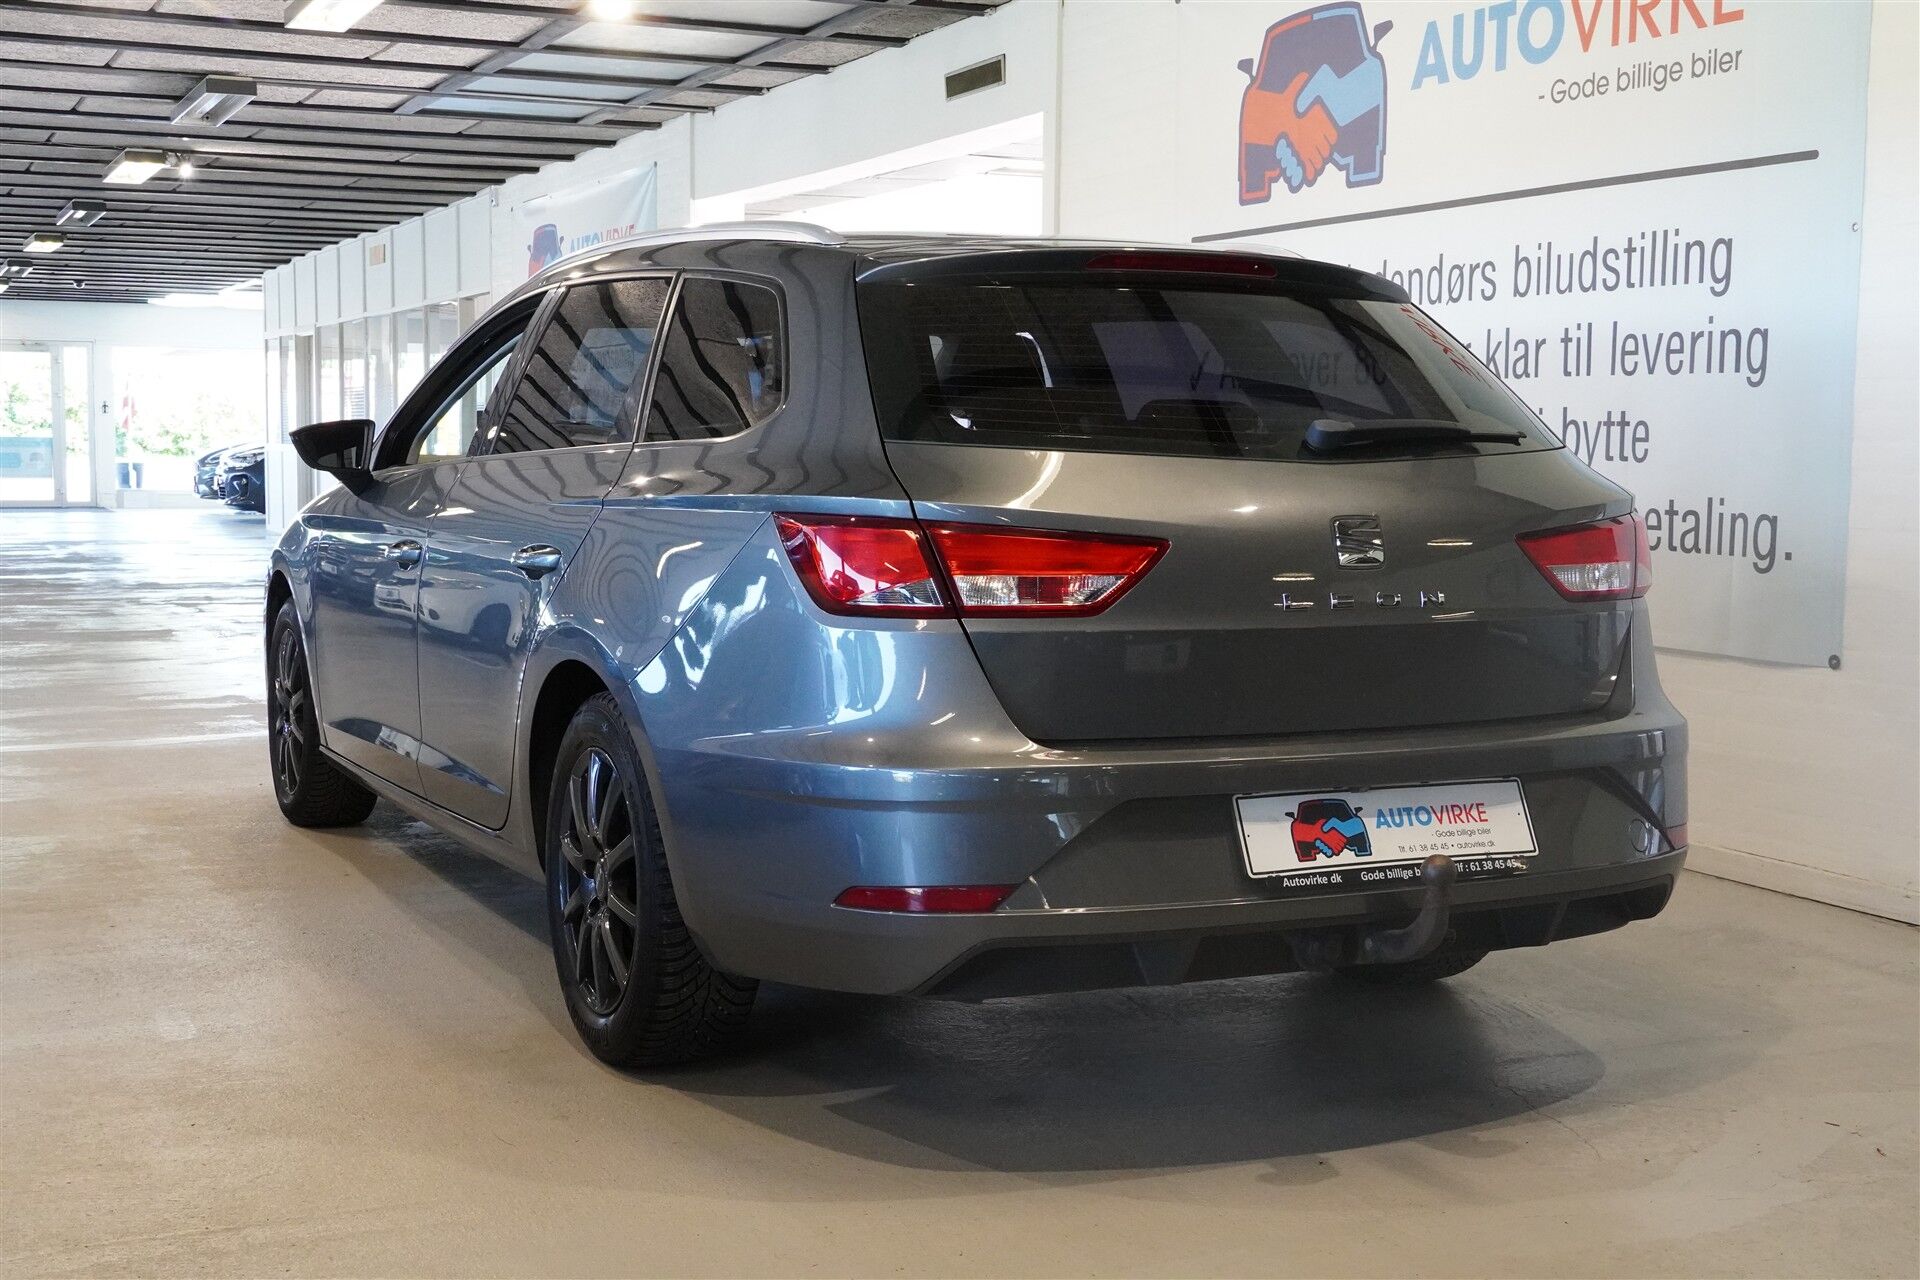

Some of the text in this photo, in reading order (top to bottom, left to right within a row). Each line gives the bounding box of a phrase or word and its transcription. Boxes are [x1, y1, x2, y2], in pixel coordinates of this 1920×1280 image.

[1550, 72, 1610, 104] Gode
[1616, 59, 1683, 92] billige
[1690, 48, 1743, 79] biler
[1512, 228, 1733, 297] biludstilling
[1485, 327, 1547, 380] klar
[1560, 322, 1593, 377] til
[1610, 315, 1769, 388] levering
[1561, 407, 1650, 467] bytte
[1645, 497, 1793, 575] etaling.
[1376, 802, 1489, 829] AUTOVIRKE
[1435, 829, 1455, 838] Gode
[1456, 828, 1476, 837] billige
[1477, 827, 1492, 836] biler
[1283, 874, 1328, 887] Autovirke
[1330, 873, 1343, 884] dk
[1360, 869, 1385, 881] Gode
[1387, 867, 1414, 880] billige
[1470, 861, 1481, 872] 61
[1482, 860, 1493, 870] 38
[1494, 859, 1505, 869] 45
[1506, 858, 1517, 868] 45
[1419, 844, 1429, 852] 38
[1430, 843, 1439, 851] 45
[1440, 842, 1450, 850] 45
